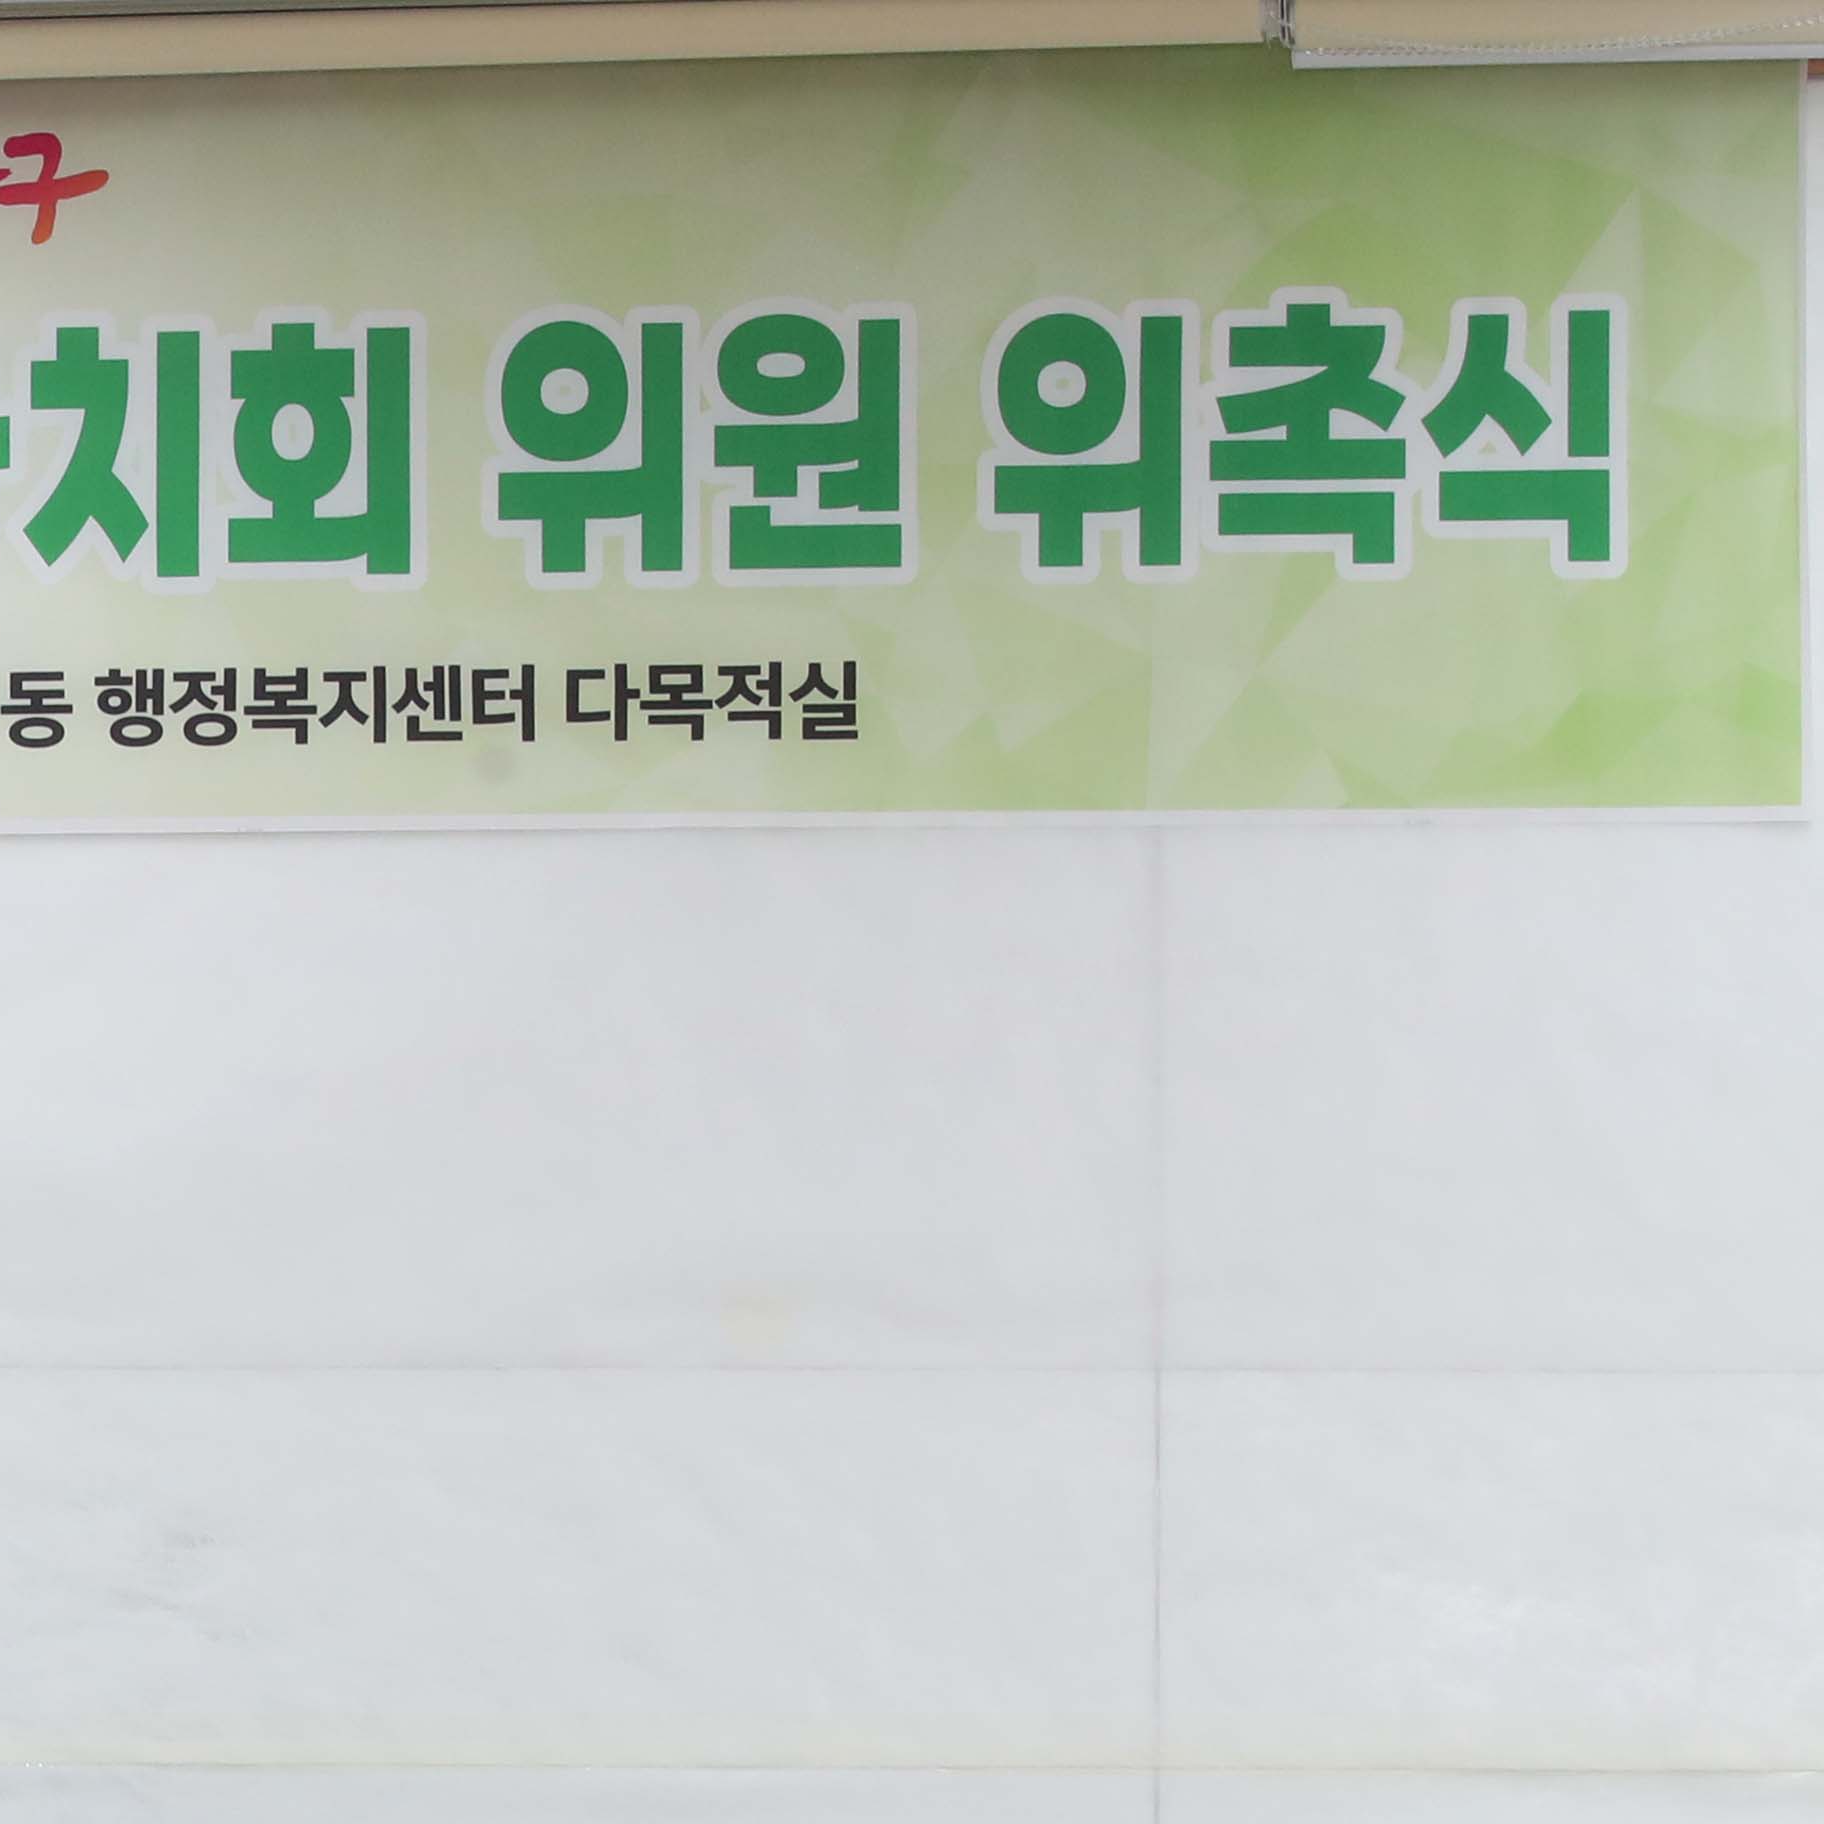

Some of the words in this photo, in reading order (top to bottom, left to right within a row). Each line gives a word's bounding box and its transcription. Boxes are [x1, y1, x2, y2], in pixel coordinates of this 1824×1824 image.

[500, 314, 902, 572] 위원
[996, 303, 1611, 567] 위촉식
[93, 662, 537, 749] 행정복지센터
[564, 659, 860, 743] 다목적실
